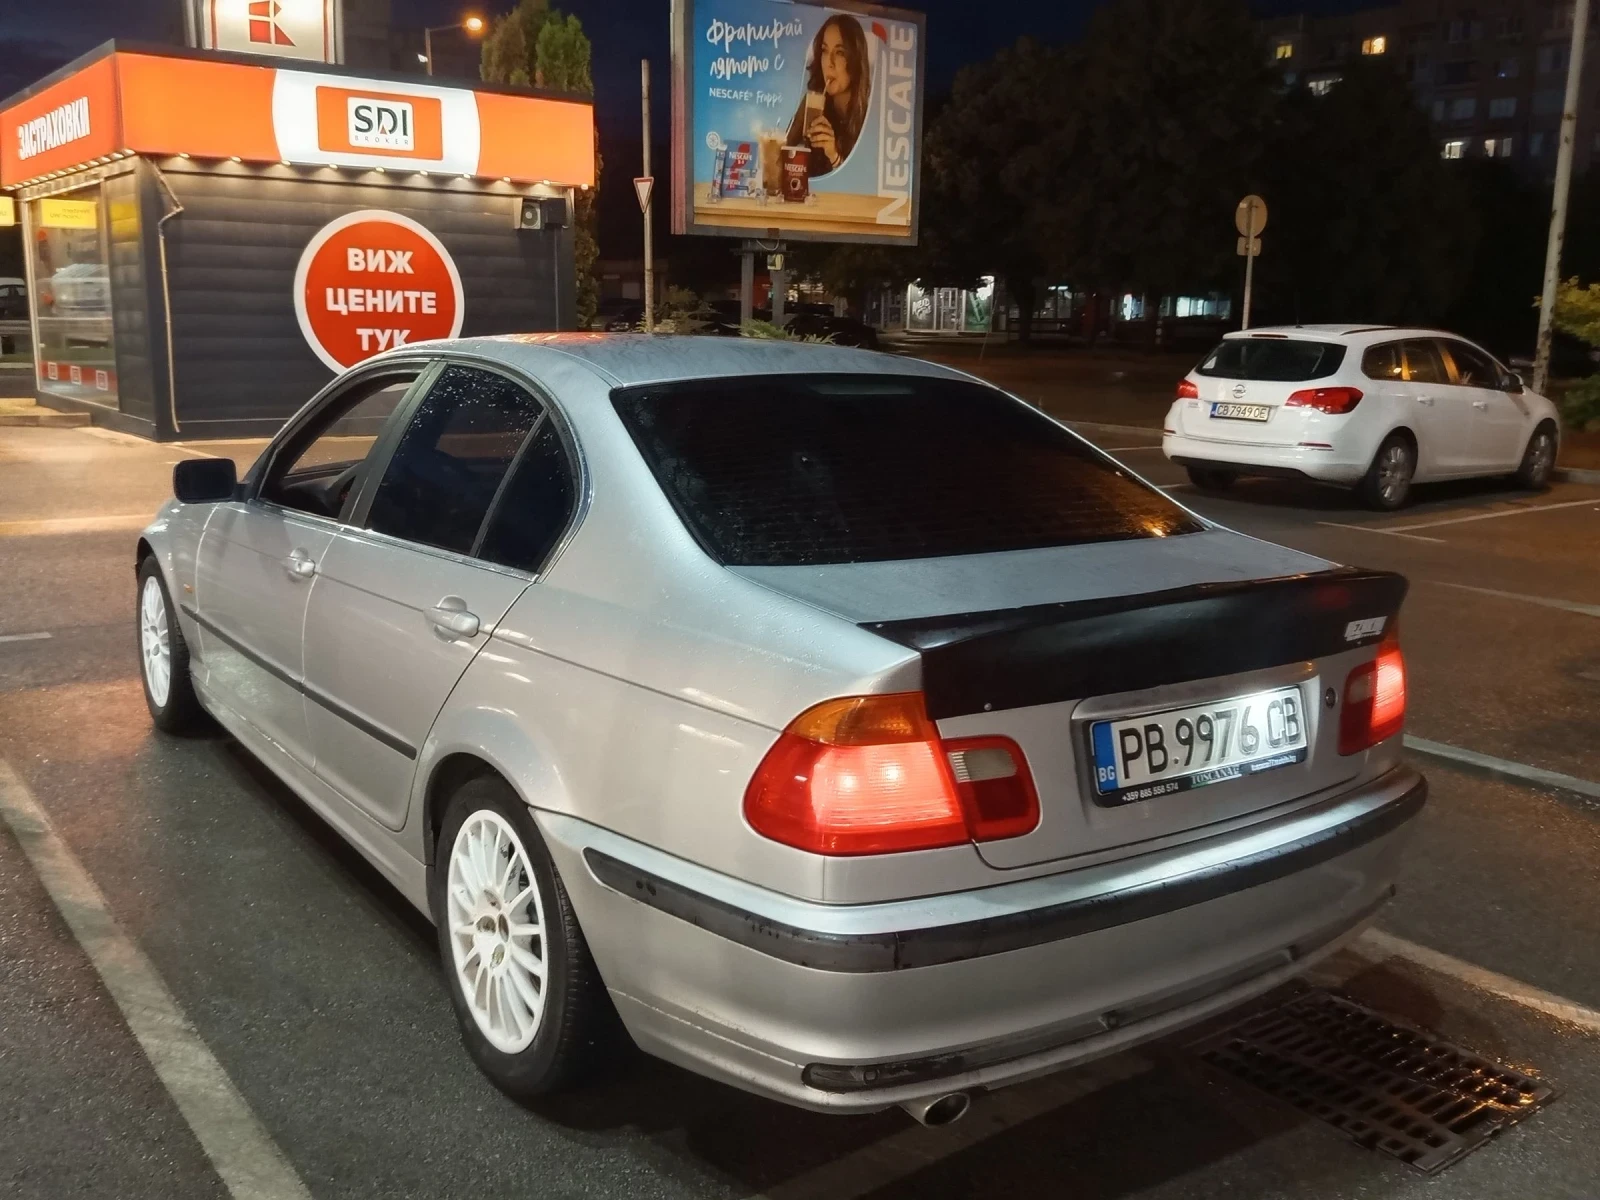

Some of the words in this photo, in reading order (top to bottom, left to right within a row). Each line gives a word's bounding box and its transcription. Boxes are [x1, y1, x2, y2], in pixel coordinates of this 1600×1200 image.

[706, 18, 803, 54] Фрапирай
[709, 55, 769, 81] лятото
[17, 96, 91, 161] ЗАСТРАХОВКИ
[354, 104, 409, 137] SDI
[354, 135, 409, 145] BROKER
[346, 247, 415, 275] ВИЖ
[325, 287, 437, 316] ЦЕНИТЕ
[355, 328, 411, 352] ТУК
[1217, 405, 1229, 416] CB
[1230, 405, 1253, 418] 7949
[1266, 696, 1300, 749] CB
[1099, 766, 1116, 783] BG
[1122, 790, 1139, 802] +359
[1166, 782, 1179, 793] 574
